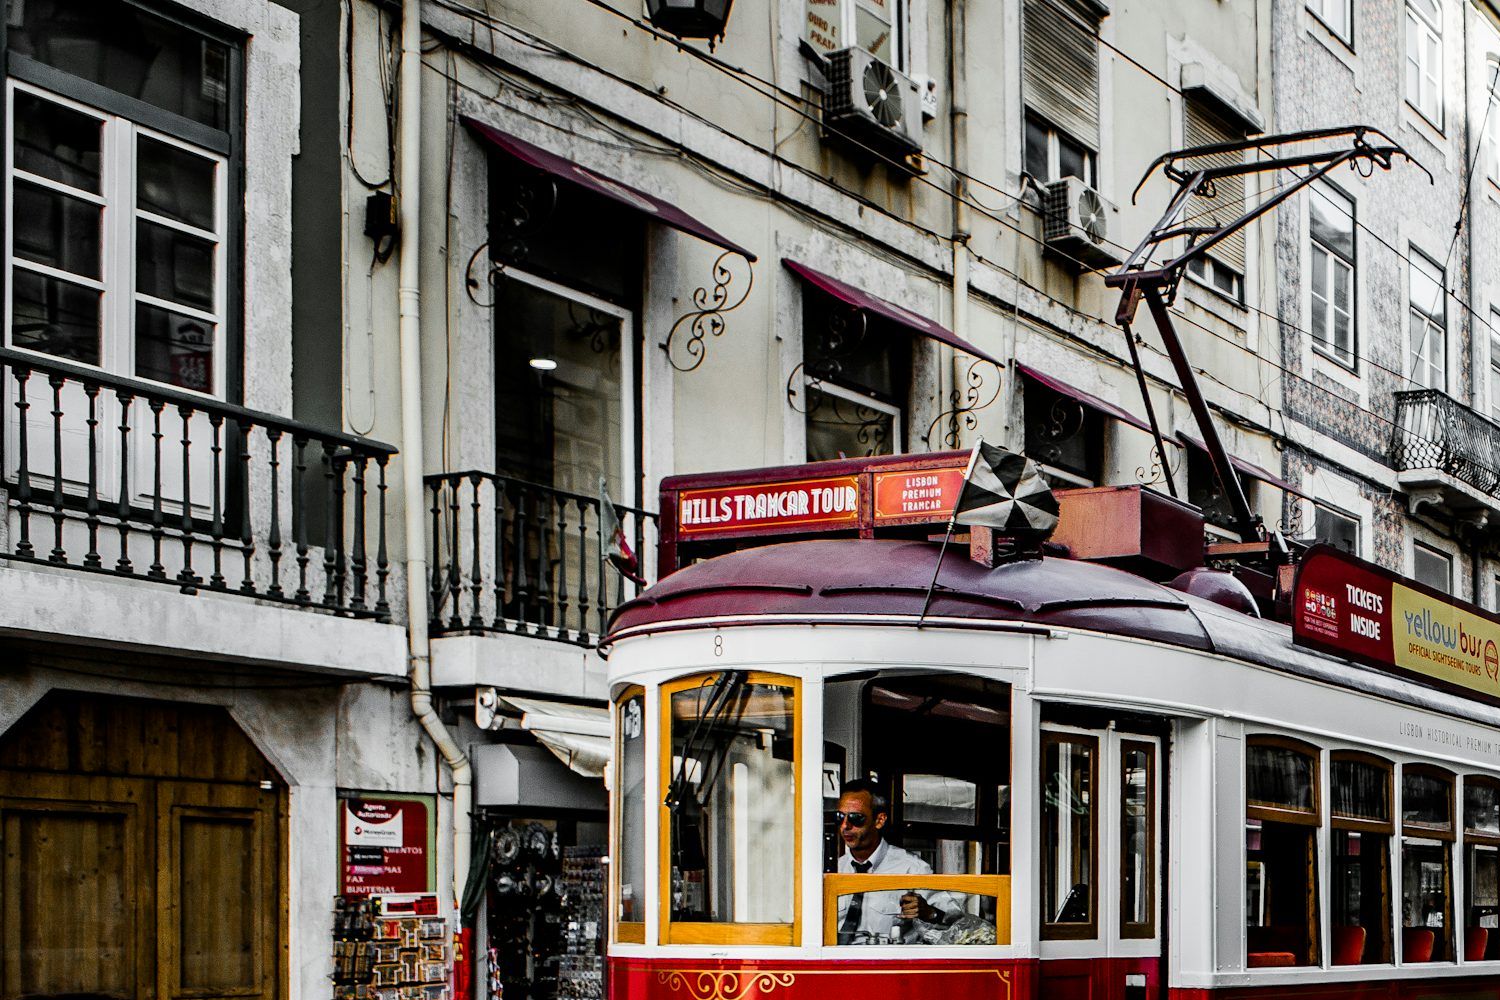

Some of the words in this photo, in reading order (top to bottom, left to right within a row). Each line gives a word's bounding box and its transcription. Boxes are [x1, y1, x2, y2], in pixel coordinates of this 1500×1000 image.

[902, 488, 942, 500] PREMIUM
[906, 476, 938, 488] LISBON
[681, 496, 732, 525] HILLS
[735, 490, 809, 520] TRAMCAR
[811, 486, 857, 514] TOUR
[902, 500, 941, 512] TRAMCAR
[1346, 583, 1383, 614] TICKETS
[1350, 613, 1381, 640] INSIDE
[1460, 622, 1482, 658] bus
[715, 635, 722, 656] 8
[1409, 642, 1431, 660] OFFICIAL
[1432, 650, 1464, 671] SIGHTSEEING
[1466, 661, 1482, 676] TOURS
[1399, 721, 1423, 738] LISBON
[1427, 728, 1462, 748] HISTORICAL
[1467, 737, 1492, 754] PREMIUM
